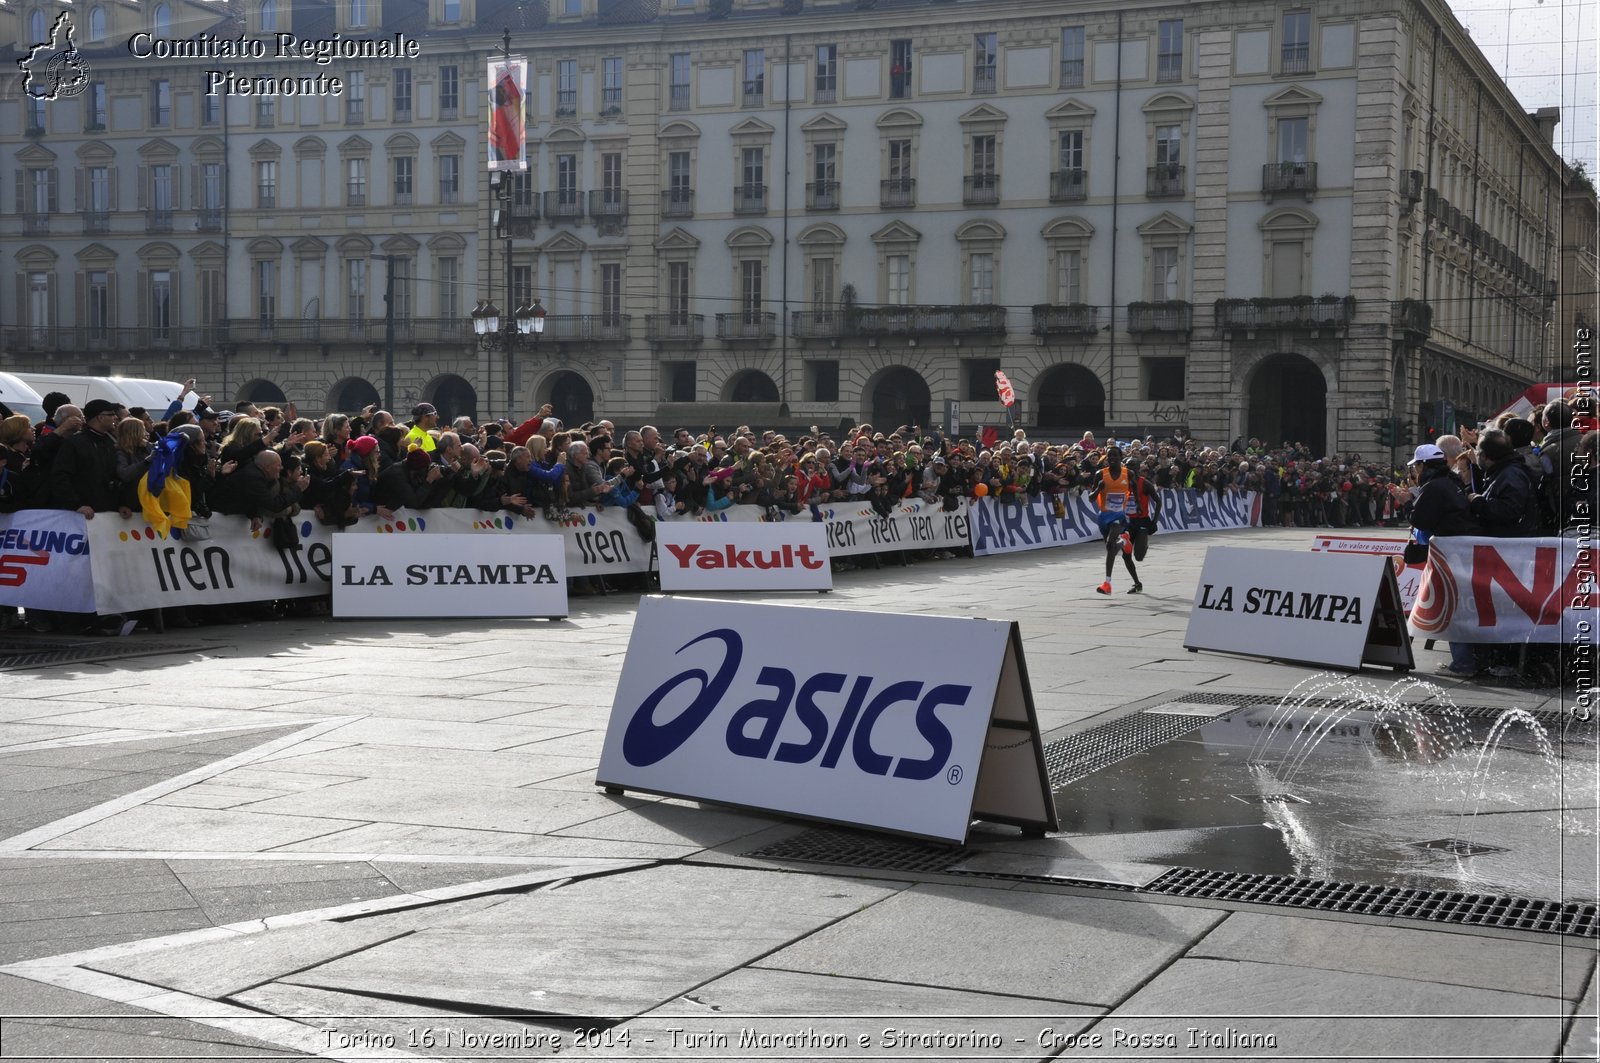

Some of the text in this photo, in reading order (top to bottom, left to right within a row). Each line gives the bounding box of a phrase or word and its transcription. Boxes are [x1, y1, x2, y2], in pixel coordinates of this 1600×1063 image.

[0, 528, 90, 555] ELUNG
[868, 517, 900, 544] iren
[909, 516, 934, 541] iren
[945, 514, 968, 539] ire
[575, 529, 631, 565] iren
[664, 543, 825, 570] Yakult
[1349, 542, 1369, 550] valore
[1371, 543, 1402, 552] aggiunto
[151, 546, 234, 592] iren
[341, 564, 559, 586] LA STAMPA
[1198, 585, 1363, 625] LA STAMPA
